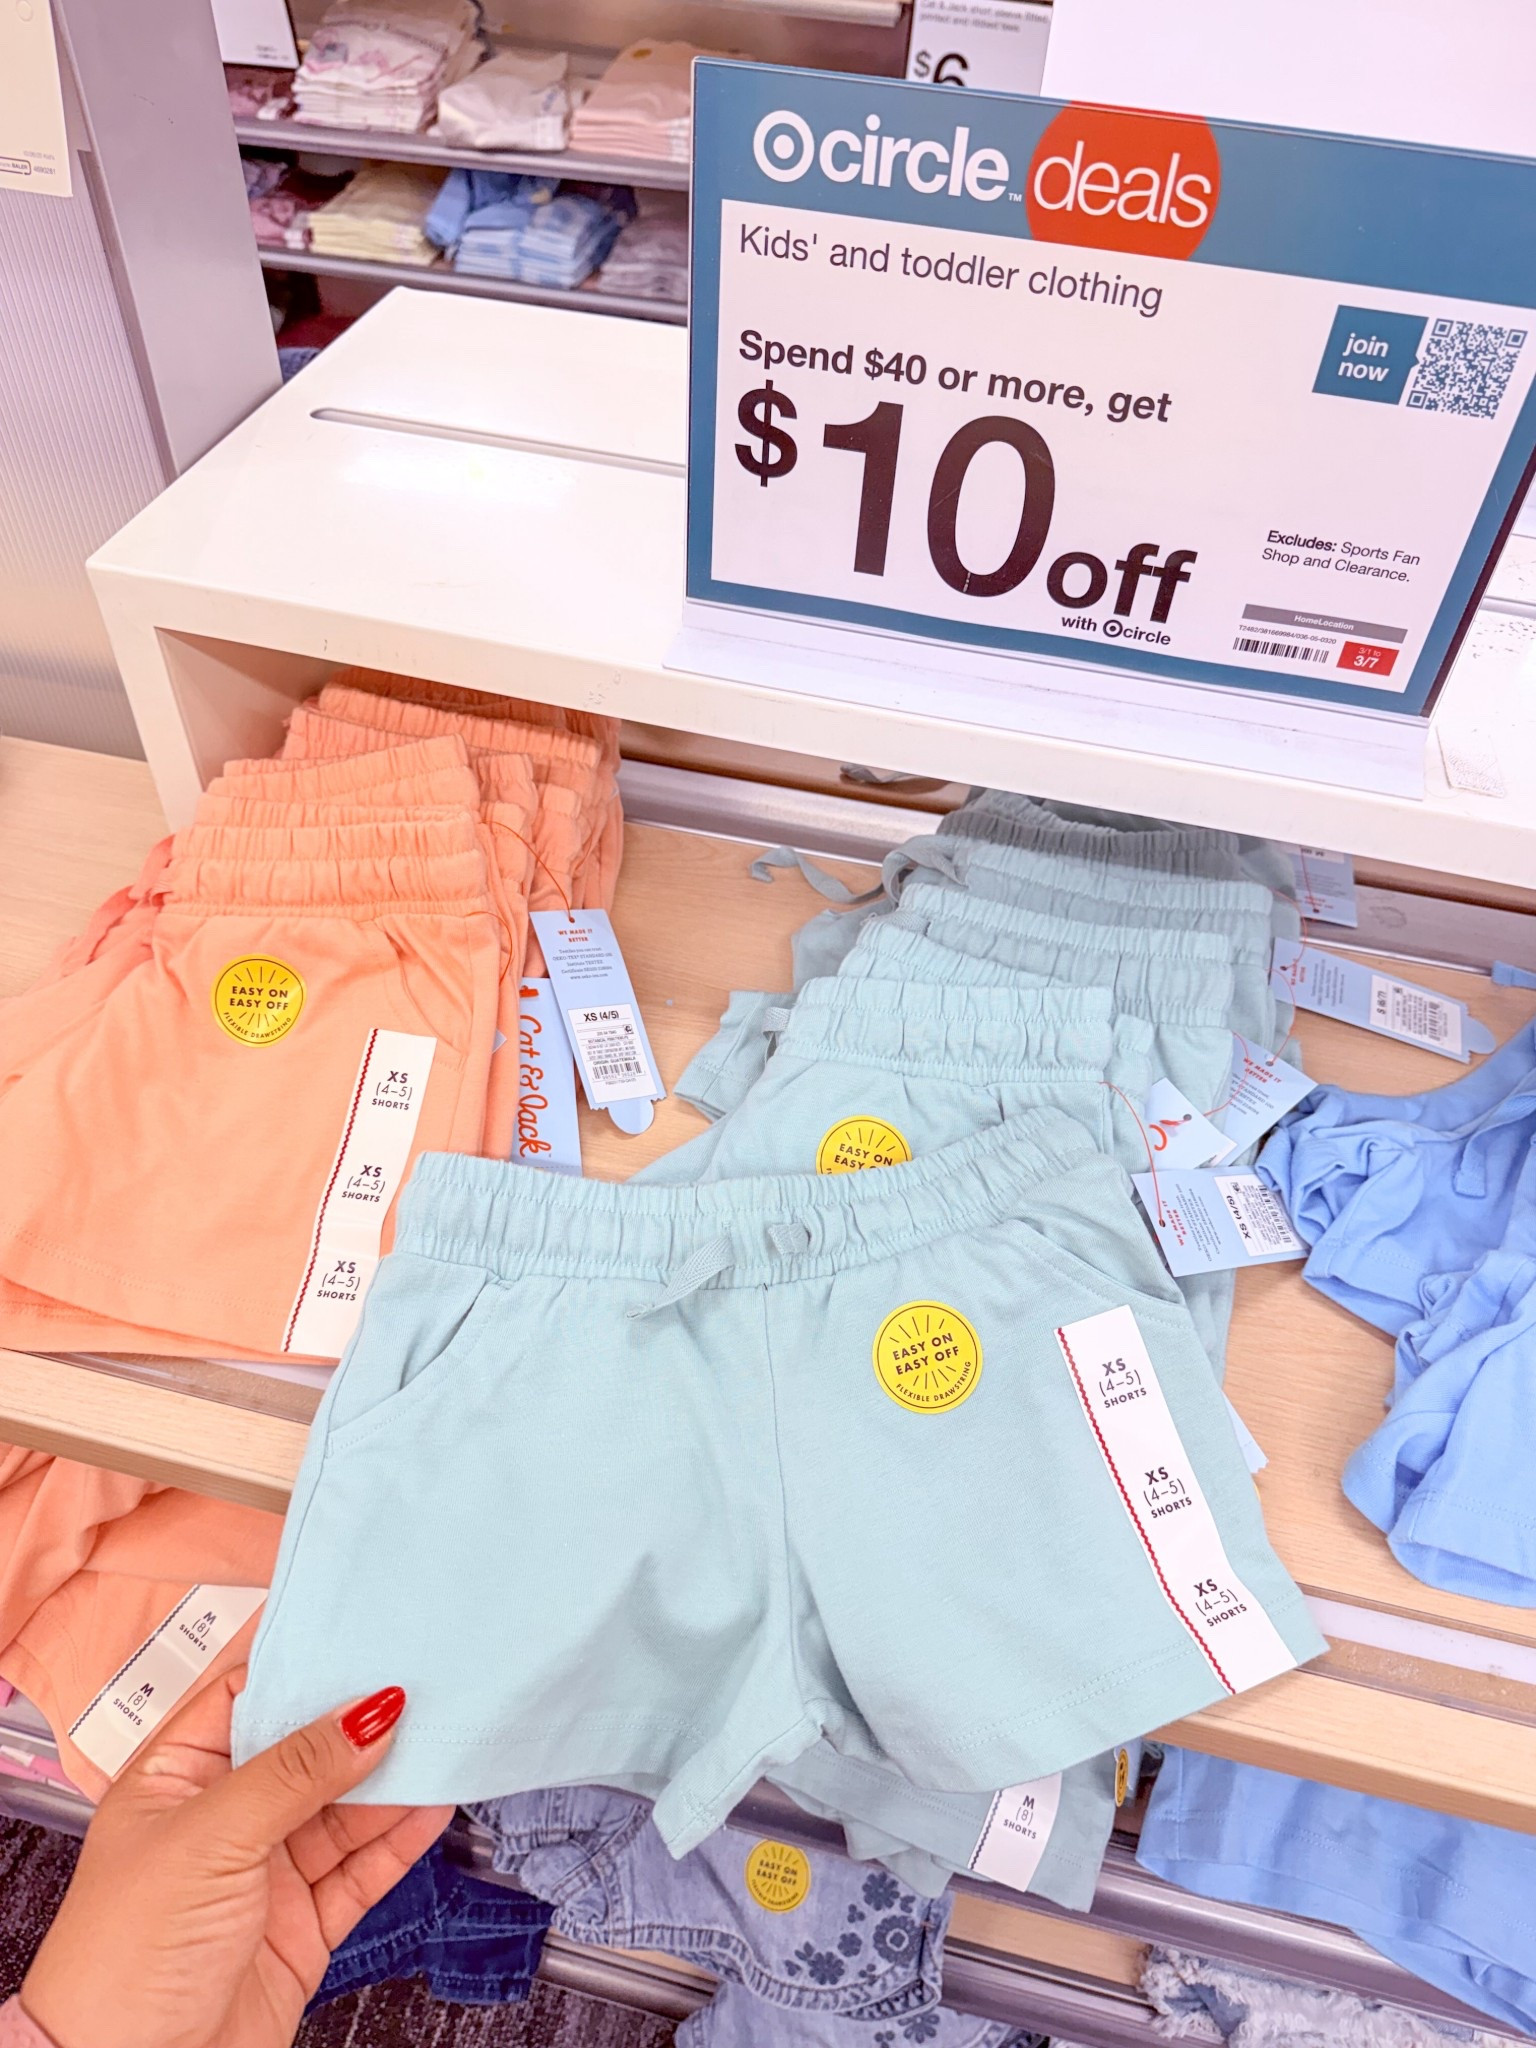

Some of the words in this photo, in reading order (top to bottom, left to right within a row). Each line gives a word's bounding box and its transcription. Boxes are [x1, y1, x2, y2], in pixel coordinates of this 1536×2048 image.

[818, 113, 1011, 202] circle
[1034, 140, 1213, 229] deals
[740, 223, 818, 262] Kids'
[829, 242, 890, 273] and
[900, 246, 1020, 291] toddler
[1028, 266, 1164, 319] clothing
[1342, 332, 1389, 358] join
[739, 329, 854, 375] Spend
[864, 347, 927, 386] $40
[938, 365, 979, 393] or
[987, 371, 1095, 417] more,
[1107, 390, 1173, 424] get
[1338, 361, 1390, 382] now
[1267, 529, 1337, 552] Excludes:
[1340, 541, 1389, 561] Sports
[1393, 550, 1421, 566] Fan
[1262, 547, 1300, 567] Shop
[1303, 556, 1332, 569] and
[1334, 559, 1411, 583] Clearance.
[1046, 542, 1199, 625] off
[1061, 615, 1098, 634] with
[1122, 624, 1172, 646] circle
[1293, 615, 1355, 631] HomeLocation
[1353, 655, 1380, 669] 3/7
[1358, 647, 1371, 656] 3/1
[1373, 649, 1382, 657] to
[231, 986, 264, 996] EASY
[268, 989, 288, 998] ON
[229, 998, 261, 1008] EASY
[266, 1001, 289, 1010] OFF
[224, 1012, 248, 1036] FLEXIBLE
[251, 1017, 292, 1038] DRAWSTRING
[584, 1012, 597, 1022] XS
[600, 1010, 619, 1020] (4/5)
[387, 1070, 408, 1084] XS
[375, 1082, 413, 1101] (4-5)
[372, 1098, 410, 1111] SHORTS
[518, 1094, 552, 1158] Jack
[834, 1155, 865, 1170] EASY
[839, 1143, 870, 1159] EASY
[873, 1154, 893, 1166] ON
[360, 1164, 382, 1178] XS
[346, 1176, 386, 1194] (4-5)
[341, 1190, 381, 1203] SHORTS
[1226, 1195, 1242, 1220] (4/5)
[1239, 1223, 1251, 1240] XS
[334, 1260, 356, 1274] XS
[321, 1273, 361, 1291] (4-5)
[316, 1289, 356, 1301] SHORTS
[892, 1341, 925, 1361] EASY
[931, 1332, 954, 1347] ON
[895, 1355, 929, 1375] EASY
[934, 1346, 959, 1361] OFF
[1102, 1358, 1127, 1377] XS
[896, 1383, 930, 1402] FLEXIBLE
[933, 1361, 972, 1402] DRAWSTRING
[1098, 1369, 1142, 1397] (4-5)
[1104, 1387, 1147, 1409] SHORTS
[1144, 1466, 1169, 1485] XS
[1143, 1478, 1186, 1507] (4-5)
[1150, 1497, 1192, 1519] SHORTS
[1193, 1578, 1218, 1598] XS
[1195, 1588, 1239, 1617] (4-5)
[203, 1611, 217, 1625] M
[1206, 1603, 1248, 1628] SHORTS
[179, 1624, 207, 1652] SHORTS
[140, 1682, 155, 1698] M
[113, 1698, 143, 1726] SHORTS
[1022, 1795, 1035, 1810] M
[1003, 1818, 1037, 1839] SHORTS
